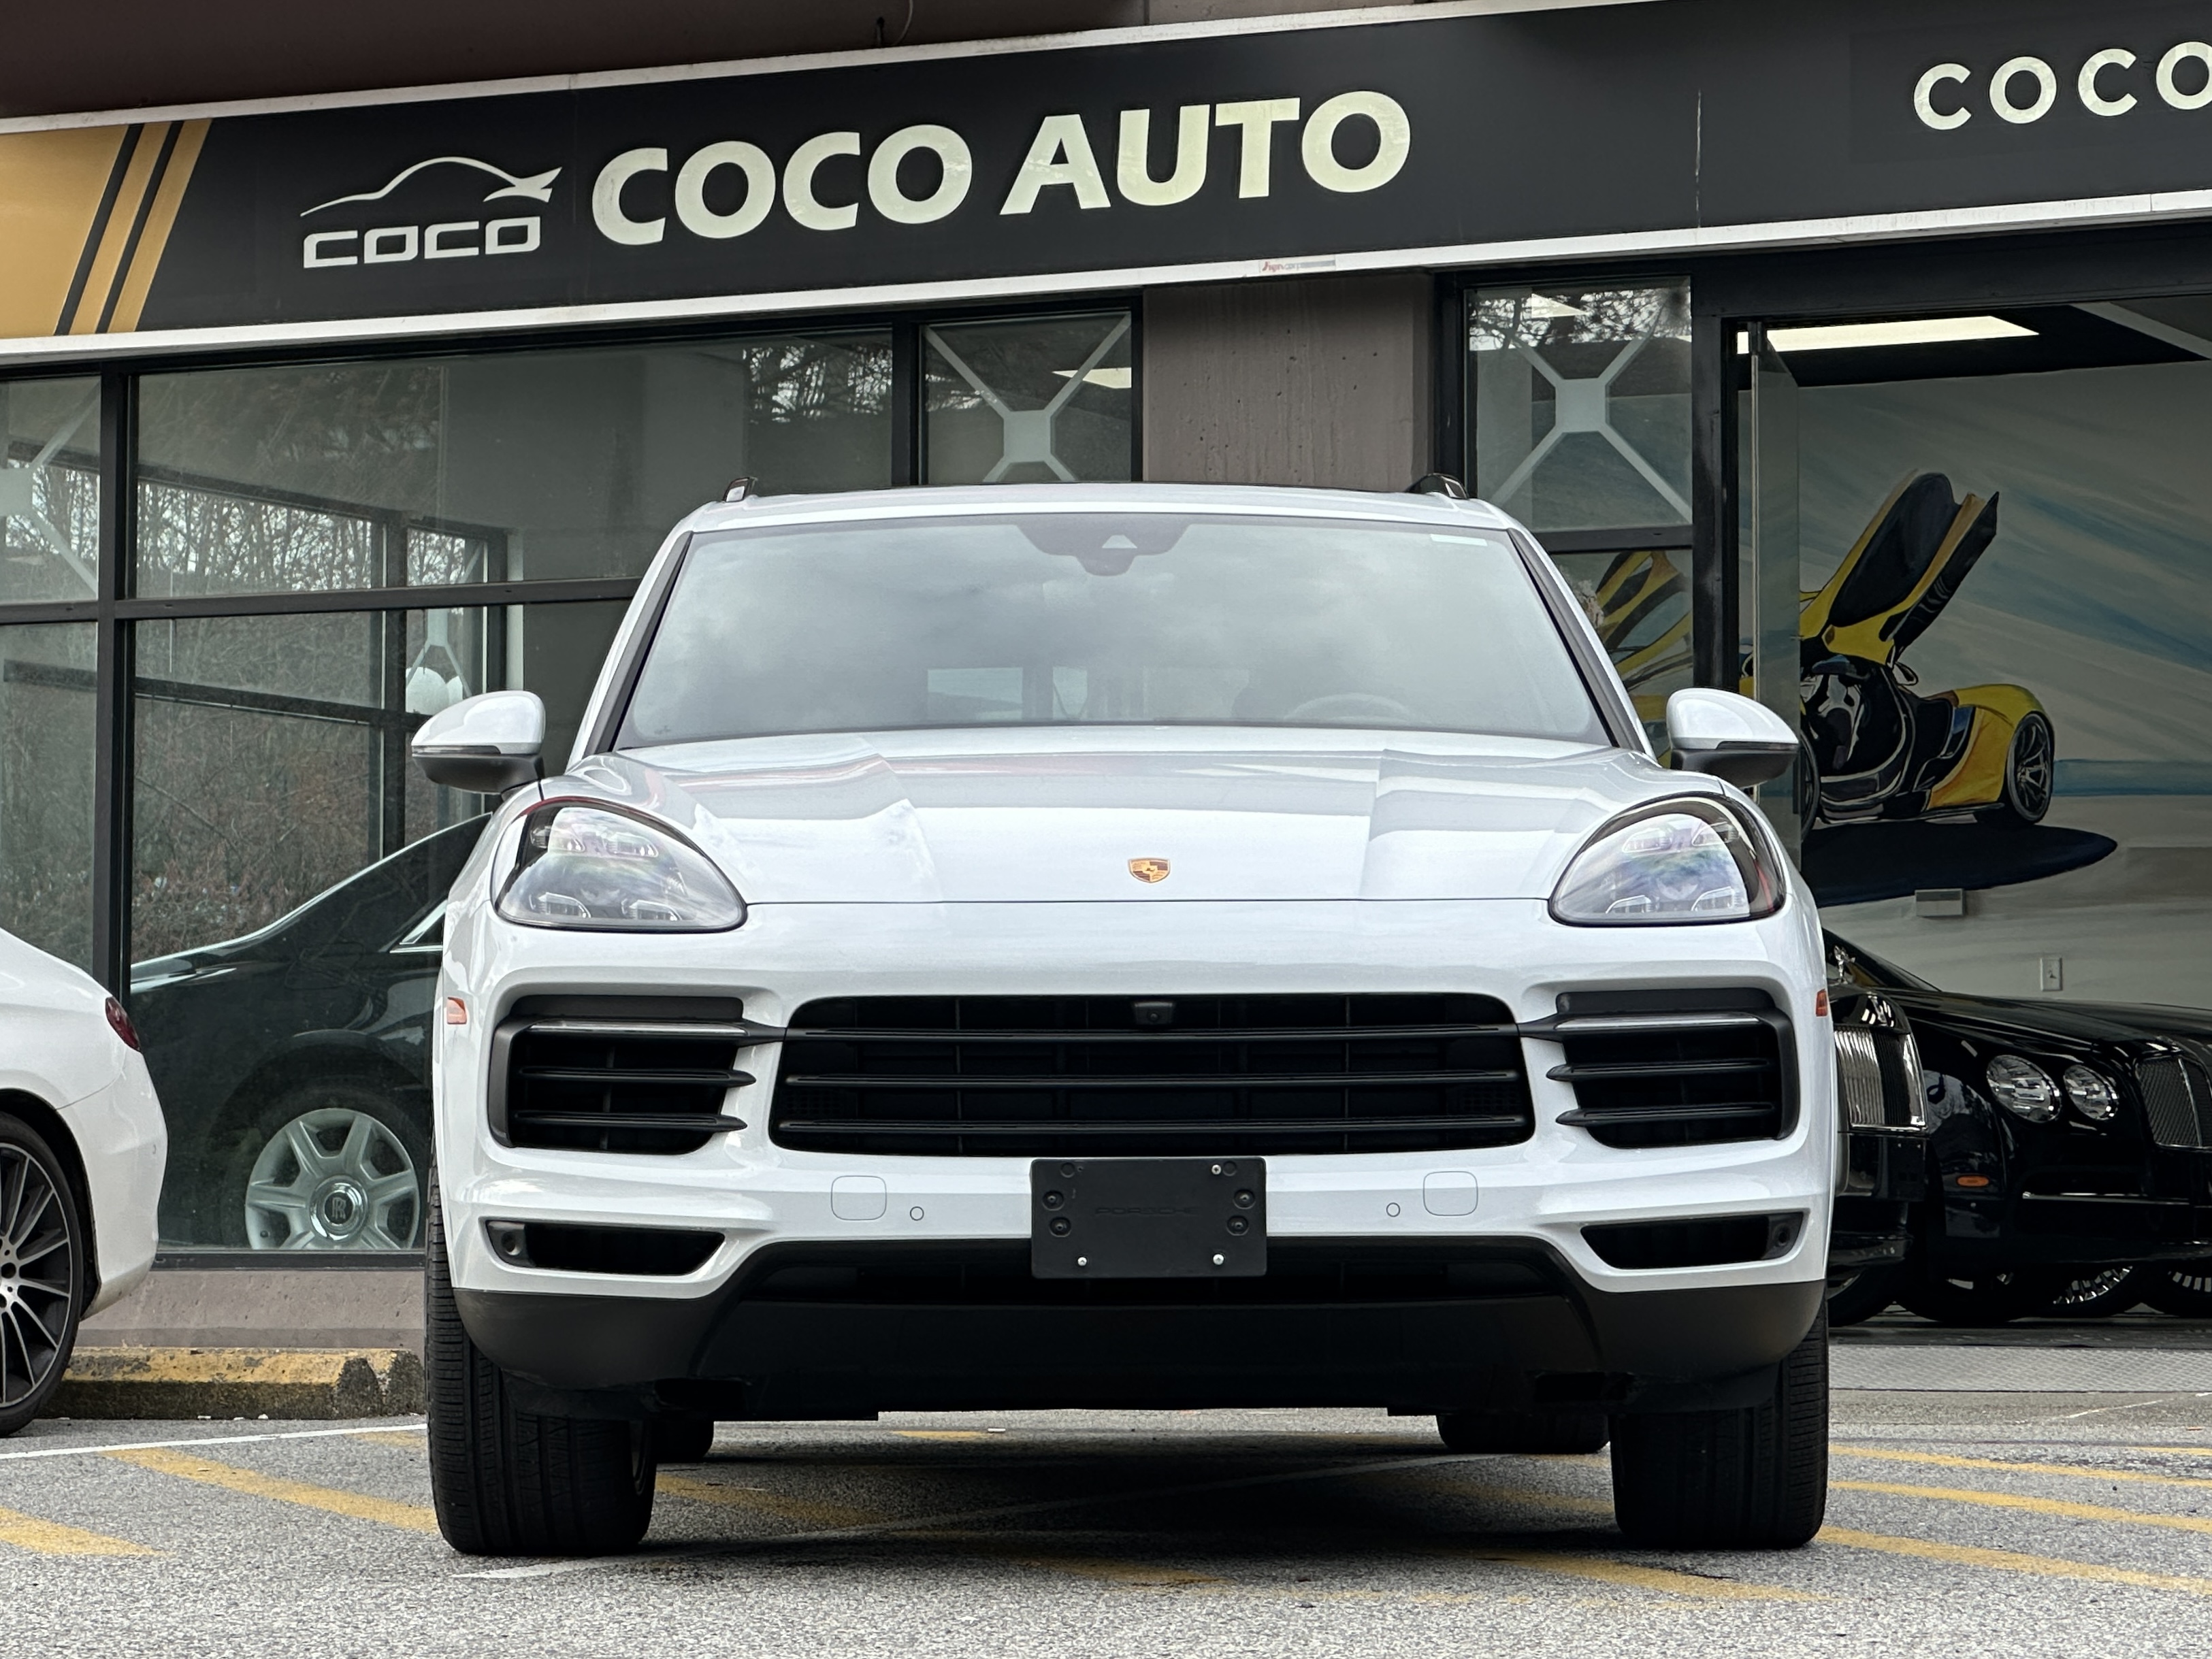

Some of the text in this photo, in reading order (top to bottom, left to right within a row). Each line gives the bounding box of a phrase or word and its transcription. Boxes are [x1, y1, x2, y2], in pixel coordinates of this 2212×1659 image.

[1913, 41, 2212, 131] COCO
[591, 91, 1411, 246] COCO AUTO
[303, 216, 540, 269] COCO
